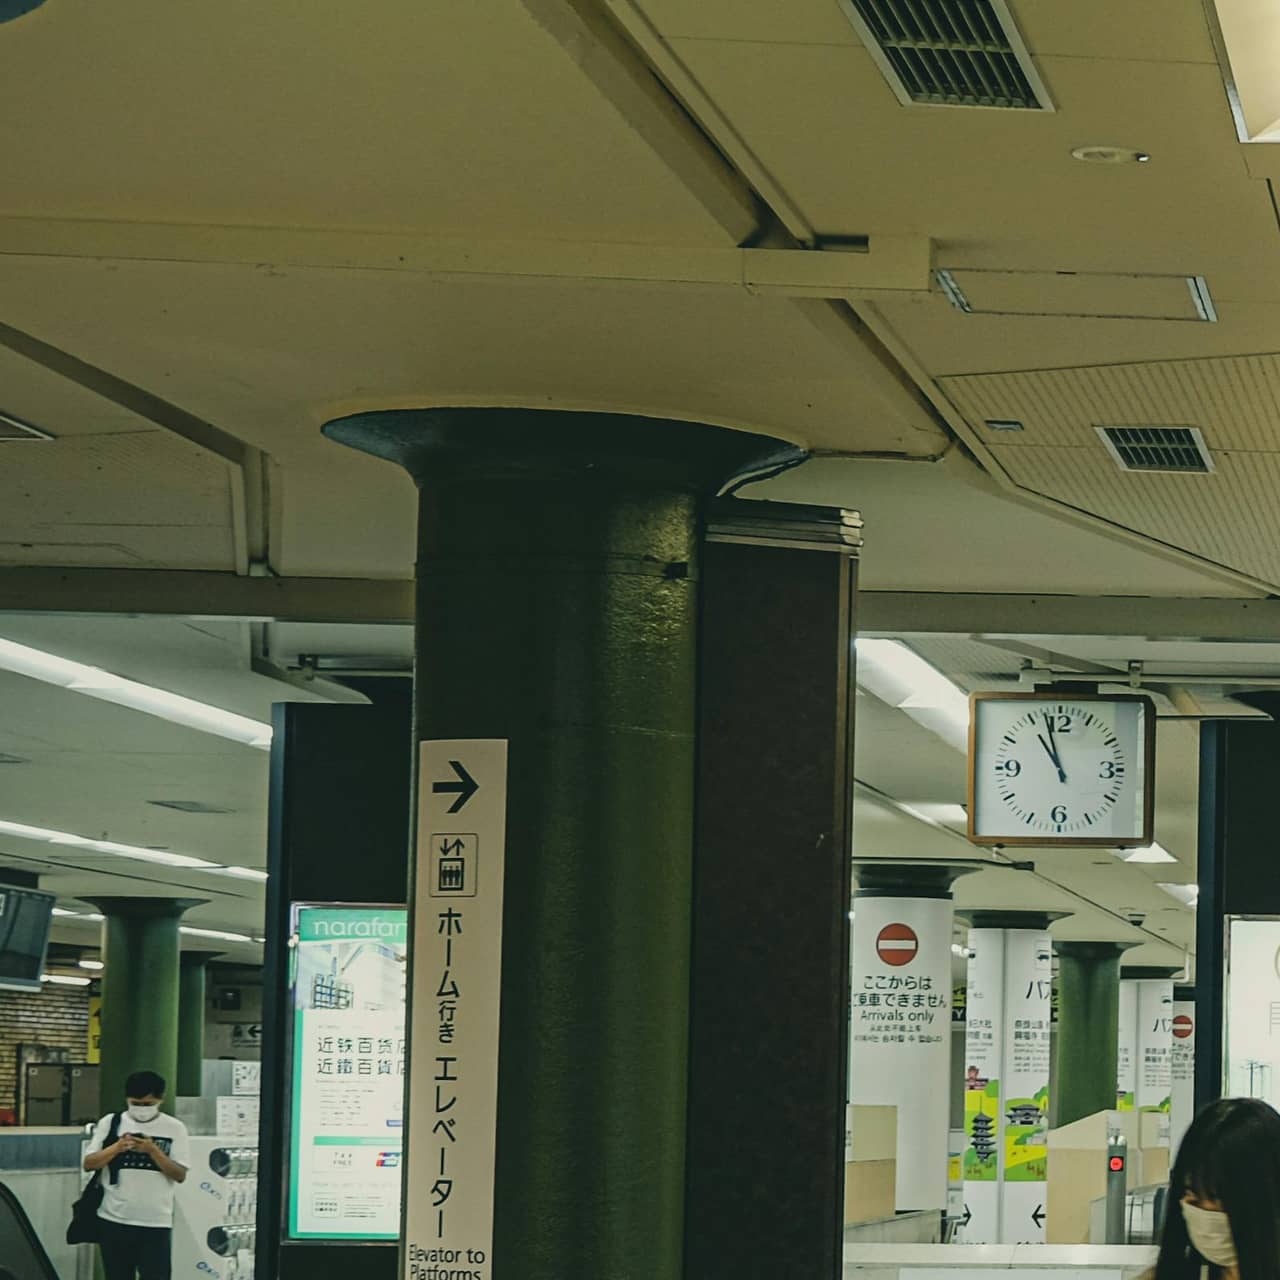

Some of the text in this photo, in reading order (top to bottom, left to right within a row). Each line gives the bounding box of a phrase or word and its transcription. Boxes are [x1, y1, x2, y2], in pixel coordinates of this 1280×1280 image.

[1049, 716, 1071, 732] 12
[1005, 760, 1115, 779] 9 3
[1051, 806, 1067, 823] 6
[436, 908, 462, 1043] ホーム行き
[864, 976, 932, 990] ここからは
[861, 1010, 934, 1024] Arrivals only
[430, 1057, 457, 1238] エレベーター
[410, 1244, 485, 1264] Elevator to
